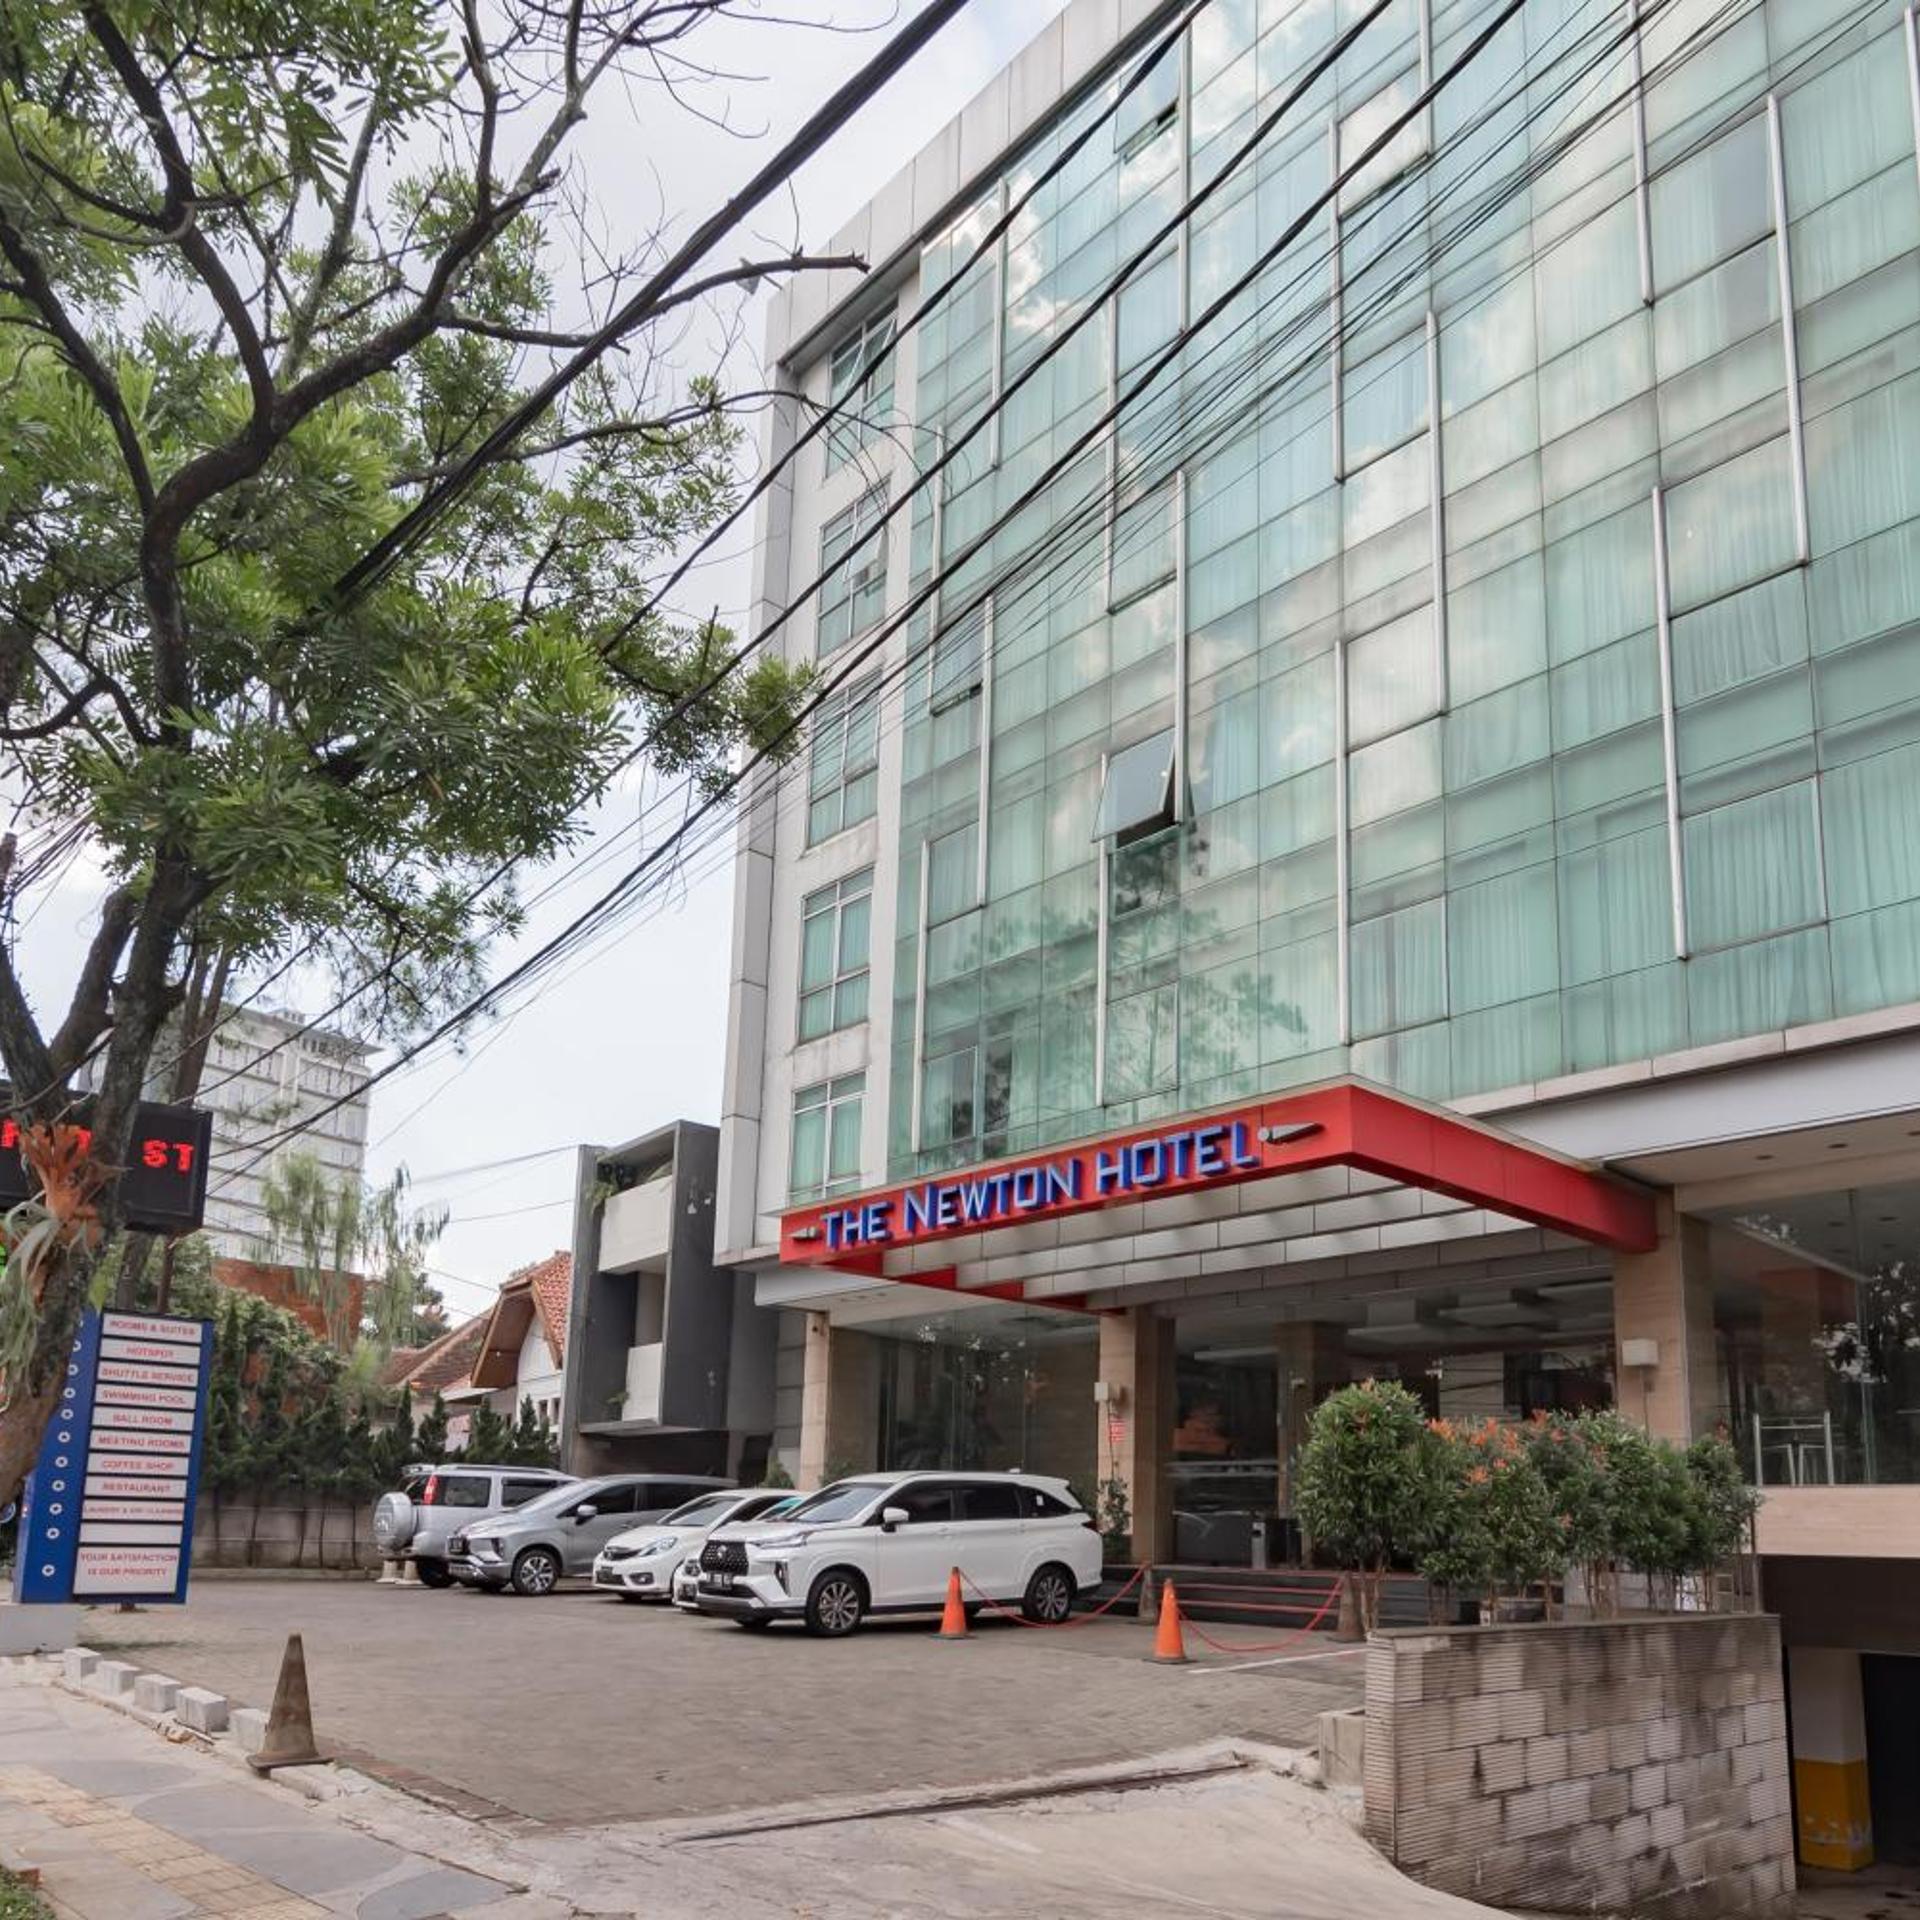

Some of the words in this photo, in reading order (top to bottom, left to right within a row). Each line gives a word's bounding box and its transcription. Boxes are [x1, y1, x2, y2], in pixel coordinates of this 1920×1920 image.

[821, 1200, 894, 1252] THE
[903, 1158, 1081, 1232] NEWTON
[1096, 1121, 1260, 1195] HOTEL
[109, 1320, 147, 1331] ROOMS
[160, 1324, 195, 1335] SUITES
[126, 1347, 174, 1358] HOTSPOT
[102, 1367, 149, 1379] SHUTTLE
[151, 1372, 195, 1383] SERVICE
[103, 1389, 157, 1402] SWIMMING
[159, 1394, 187, 1404] POOL
[113, 1414, 138, 1424] BALL
[141, 1415, 173, 1426] ROOM
[98, 1435, 145, 1447] MEETING
[147, 1438, 186, 1448] ROOMS
[102, 1460, 142, 1470] COFFEE
[146, 1461, 174, 1471] SHOP
[102, 1482, 171, 1493] RESTAURANT
[80, 1551, 108, 1561] YOUR
[110, 1552, 178, 1562] SATISFACTION
[98, 1567, 120, 1576] OUR
[122, 1567, 167, 1577] PRIORITY
